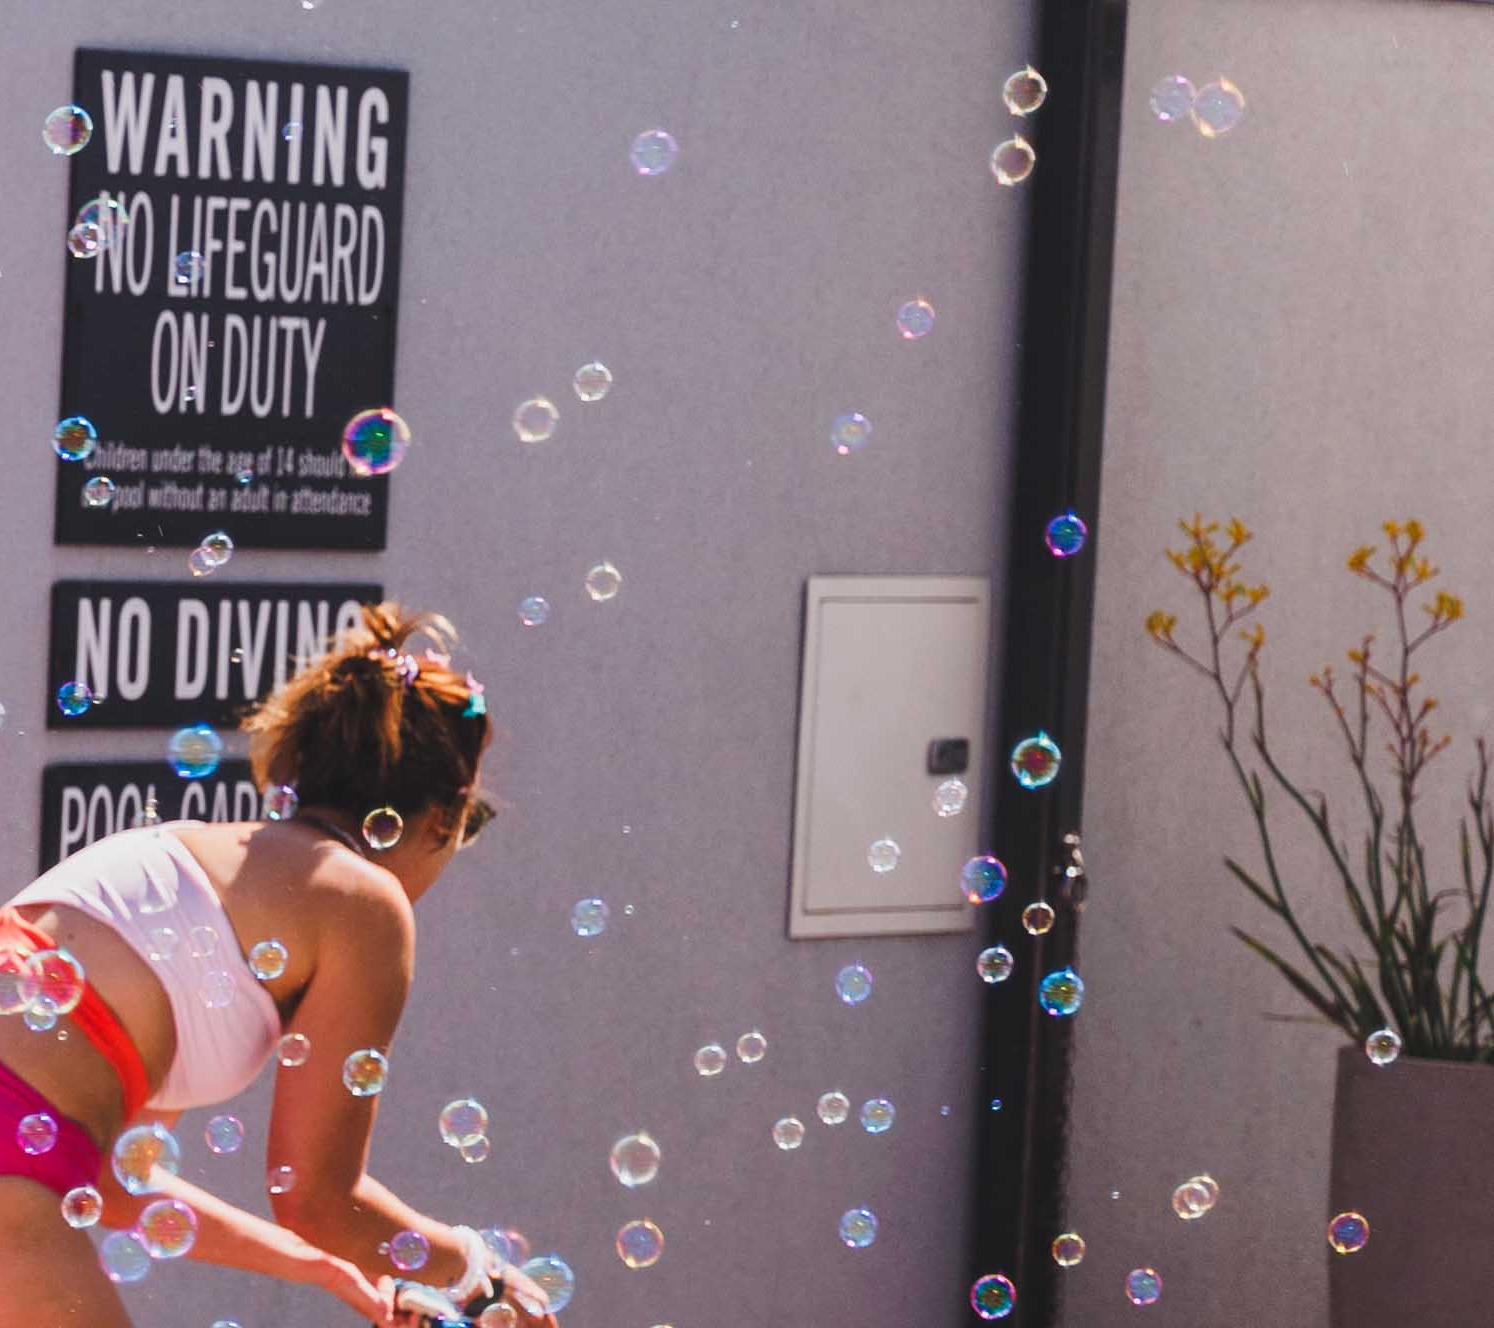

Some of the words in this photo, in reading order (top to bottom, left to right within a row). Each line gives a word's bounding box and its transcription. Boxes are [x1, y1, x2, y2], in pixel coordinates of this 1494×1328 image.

[101, 70, 389, 190] WARNING
[95, 190, 153, 296] NO
[167, 194, 384, 306] LIFEGUARD
[150, 309, 209, 415] ON
[221, 315, 325, 419] DUTY
[84, 439, 147, 471] Children
[152, 444, 194, 472] under
[198, 444, 220, 473] the
[256, 446, 272, 474] of
[276, 446, 293, 476] 14
[299, 448, 345, 477] should
[149, 485, 203, 510] without
[231, 486, 268, 512] adult
[292, 488, 372, 516] attendance
[76, 596, 152, 701] NO
